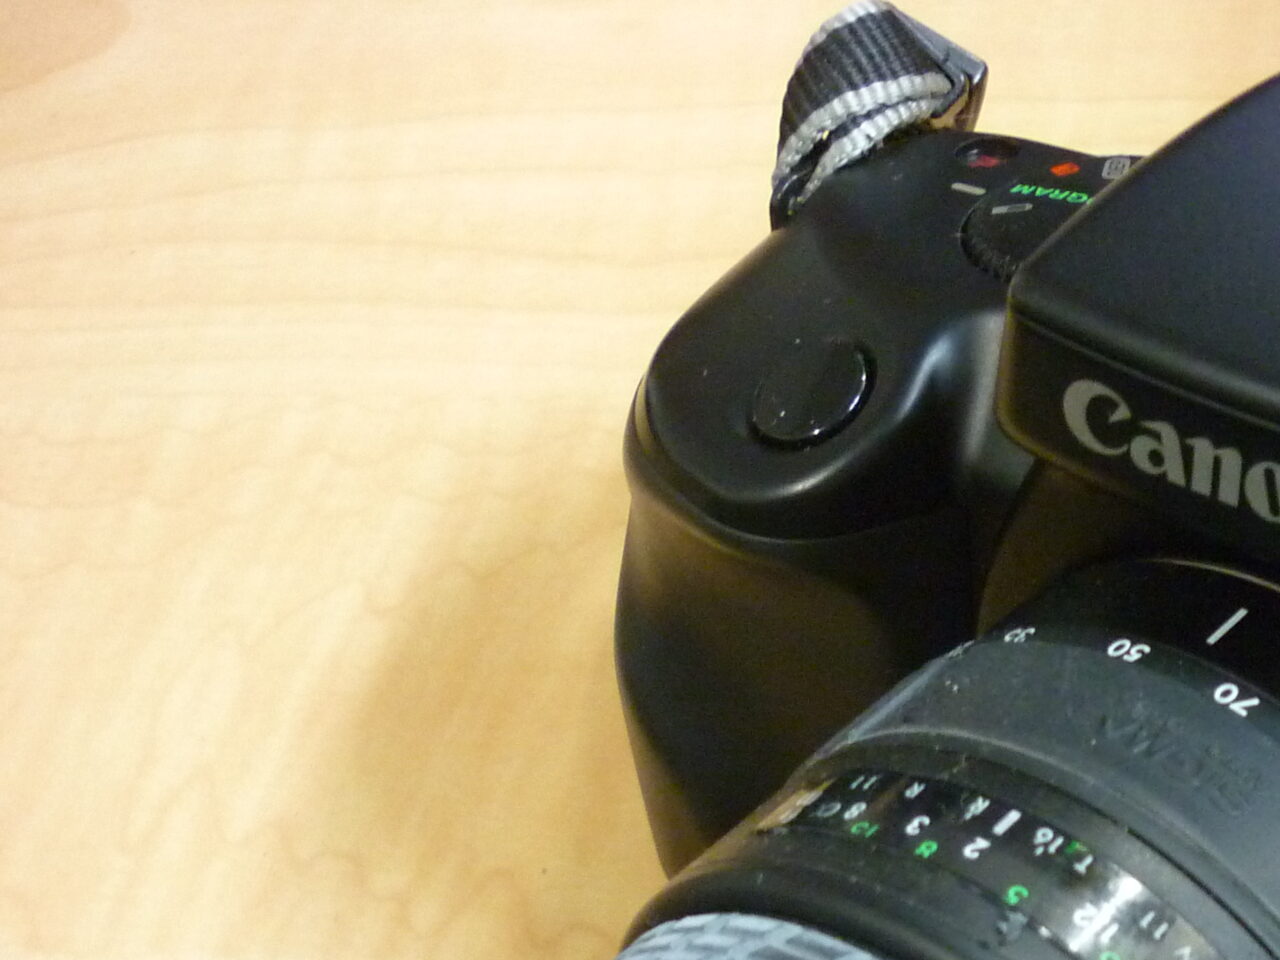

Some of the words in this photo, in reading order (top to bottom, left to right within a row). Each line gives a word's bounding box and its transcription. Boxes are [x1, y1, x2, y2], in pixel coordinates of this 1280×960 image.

[1106, 638, 1152, 664] 50
[1212, 682, 1261, 718] 70
[904, 815, 931, 836] 3
[962, 836, 991, 860] 2
